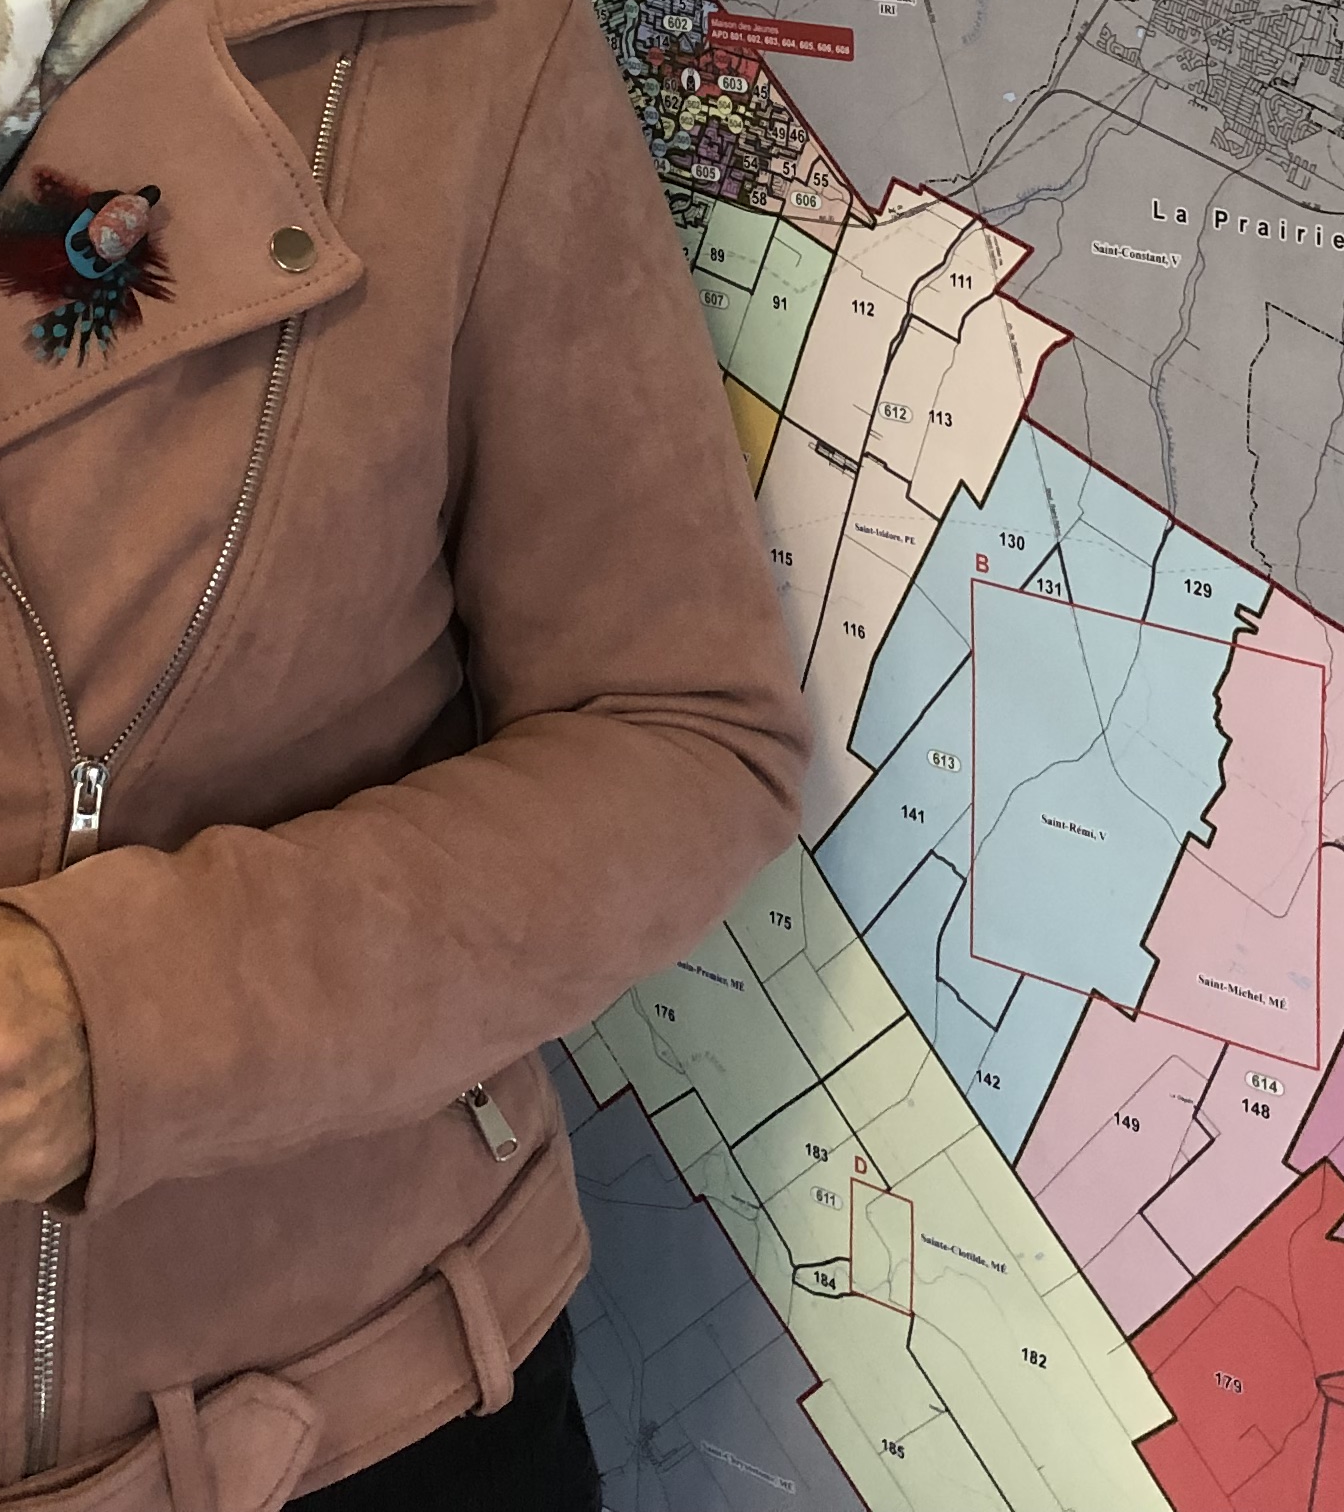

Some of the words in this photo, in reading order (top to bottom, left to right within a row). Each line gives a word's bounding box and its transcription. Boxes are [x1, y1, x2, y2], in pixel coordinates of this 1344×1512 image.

[667, 16, 688, 31] 602
[722, 76, 743, 91] 603
[789, 128, 805, 143] 46
[743, 155, 759, 169] 54
[782, 161, 797, 176] 51
[695, 166, 716, 180] 605
[812, 172, 829, 187] 55
[751, 190, 767, 206] 58
[795, 192, 817, 207] 606
[709, 248, 725, 264] 89
[949, 272, 973, 290] 111
[703, 292, 724, 306] 607
[772, 295, 788, 312] 91
[851, 300, 875, 318] 112
[884, 405, 907, 421] 612
[928, 410, 953, 428] 113
[998, 532, 1026, 551] 130
[769, 547, 795, 566] 115
[975, 553, 990, 574] B
[1035, 578, 1062, 597] 131
[1183, 579, 1213, 598] 129
[841, 621, 867, 640] 116
[931, 750, 956, 769] 613
[900, 804, 926, 824] 141
[768, 910, 793, 930] 175
[1197, 974, 1266, 1005] Saint-Michel,
[653, 1003, 676, 1022] 176
[975, 1069, 1001, 1090] 142
[1250, 1073, 1278, 1094] 614
[1241, 1098, 1271, 1120] 148
[1112, 1111, 1141, 1133] 149
[804, 1142, 829, 1163] 183
[854, 1156, 867, 1174] D
[814, 1190, 838, 1207] 611
[812, 1270, 837, 1290] 184
[1020, 1347, 1048, 1369] 182
[1213, 1371, 1244, 1394] 179
[881, 1438, 905, 1459] 185
